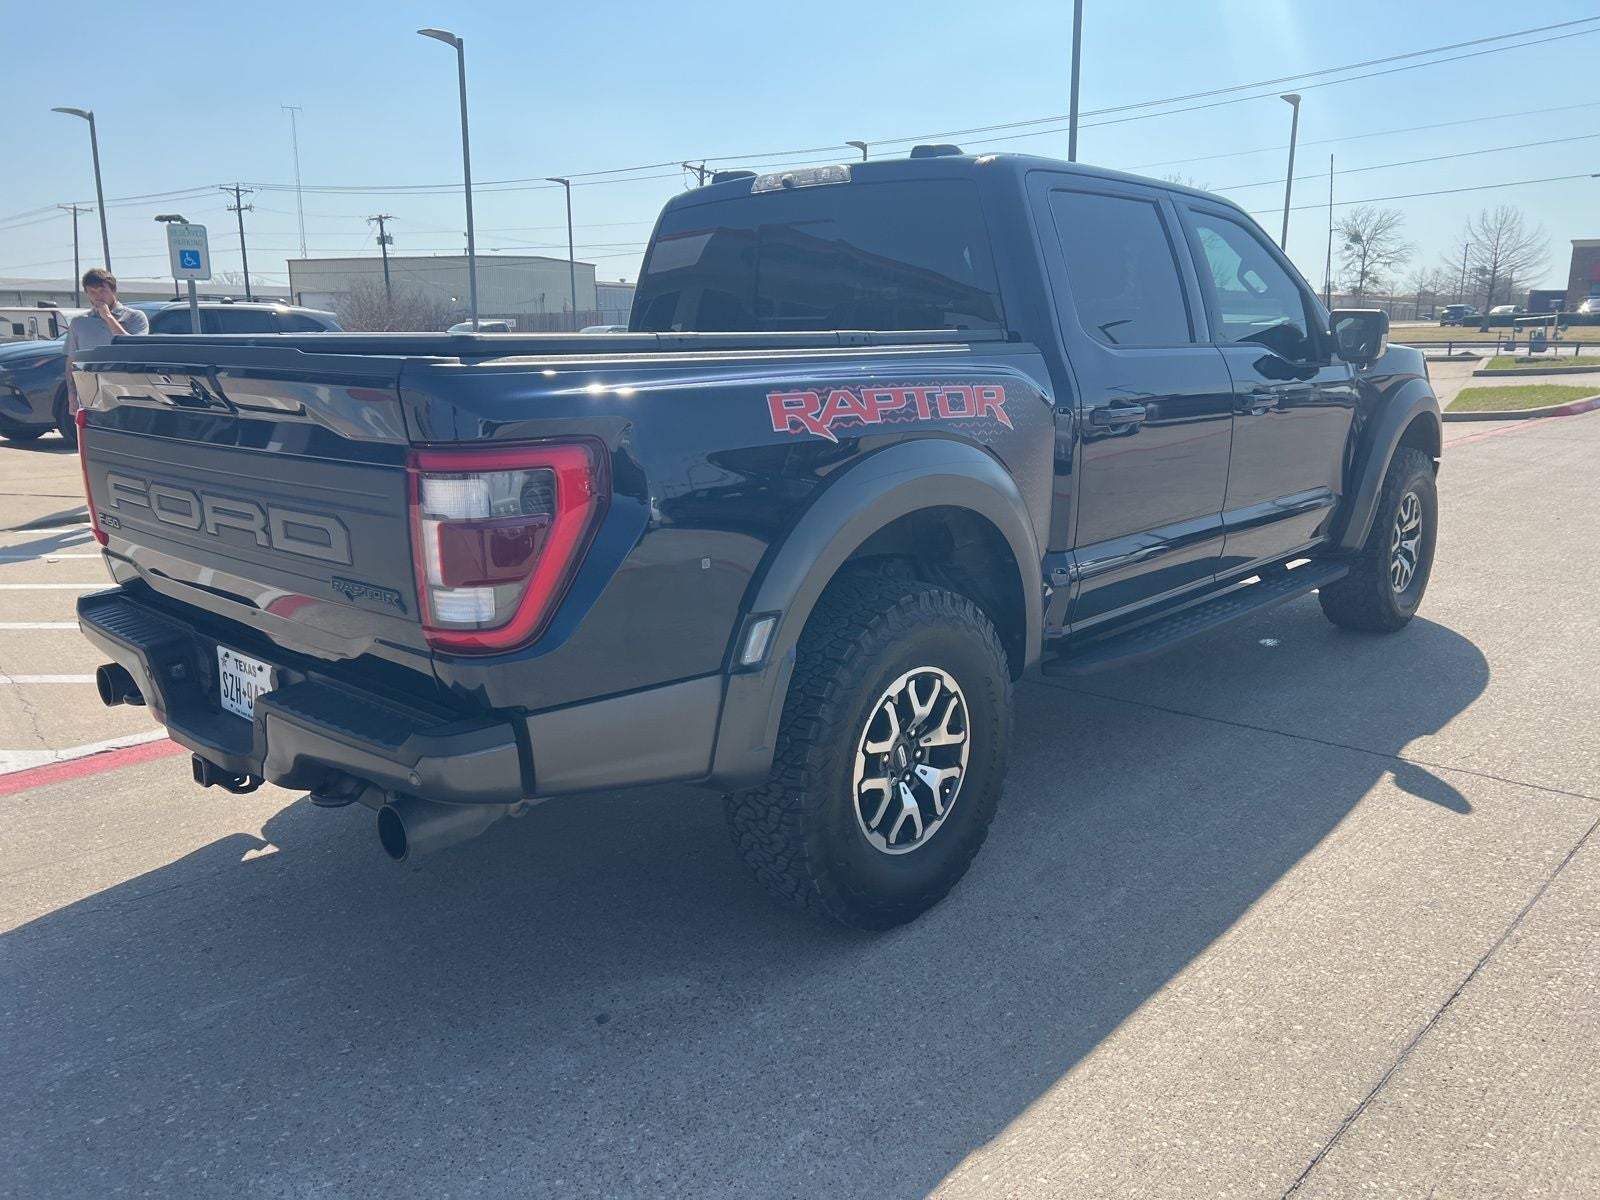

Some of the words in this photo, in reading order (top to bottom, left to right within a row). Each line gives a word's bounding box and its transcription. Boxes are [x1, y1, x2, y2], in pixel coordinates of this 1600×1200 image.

[766, 385, 1014, 443] RAPTOR
[105, 471, 354, 566] FORD
[332, 576, 408, 615] RAPTOR
[233, 658, 257, 678] TEXAS
